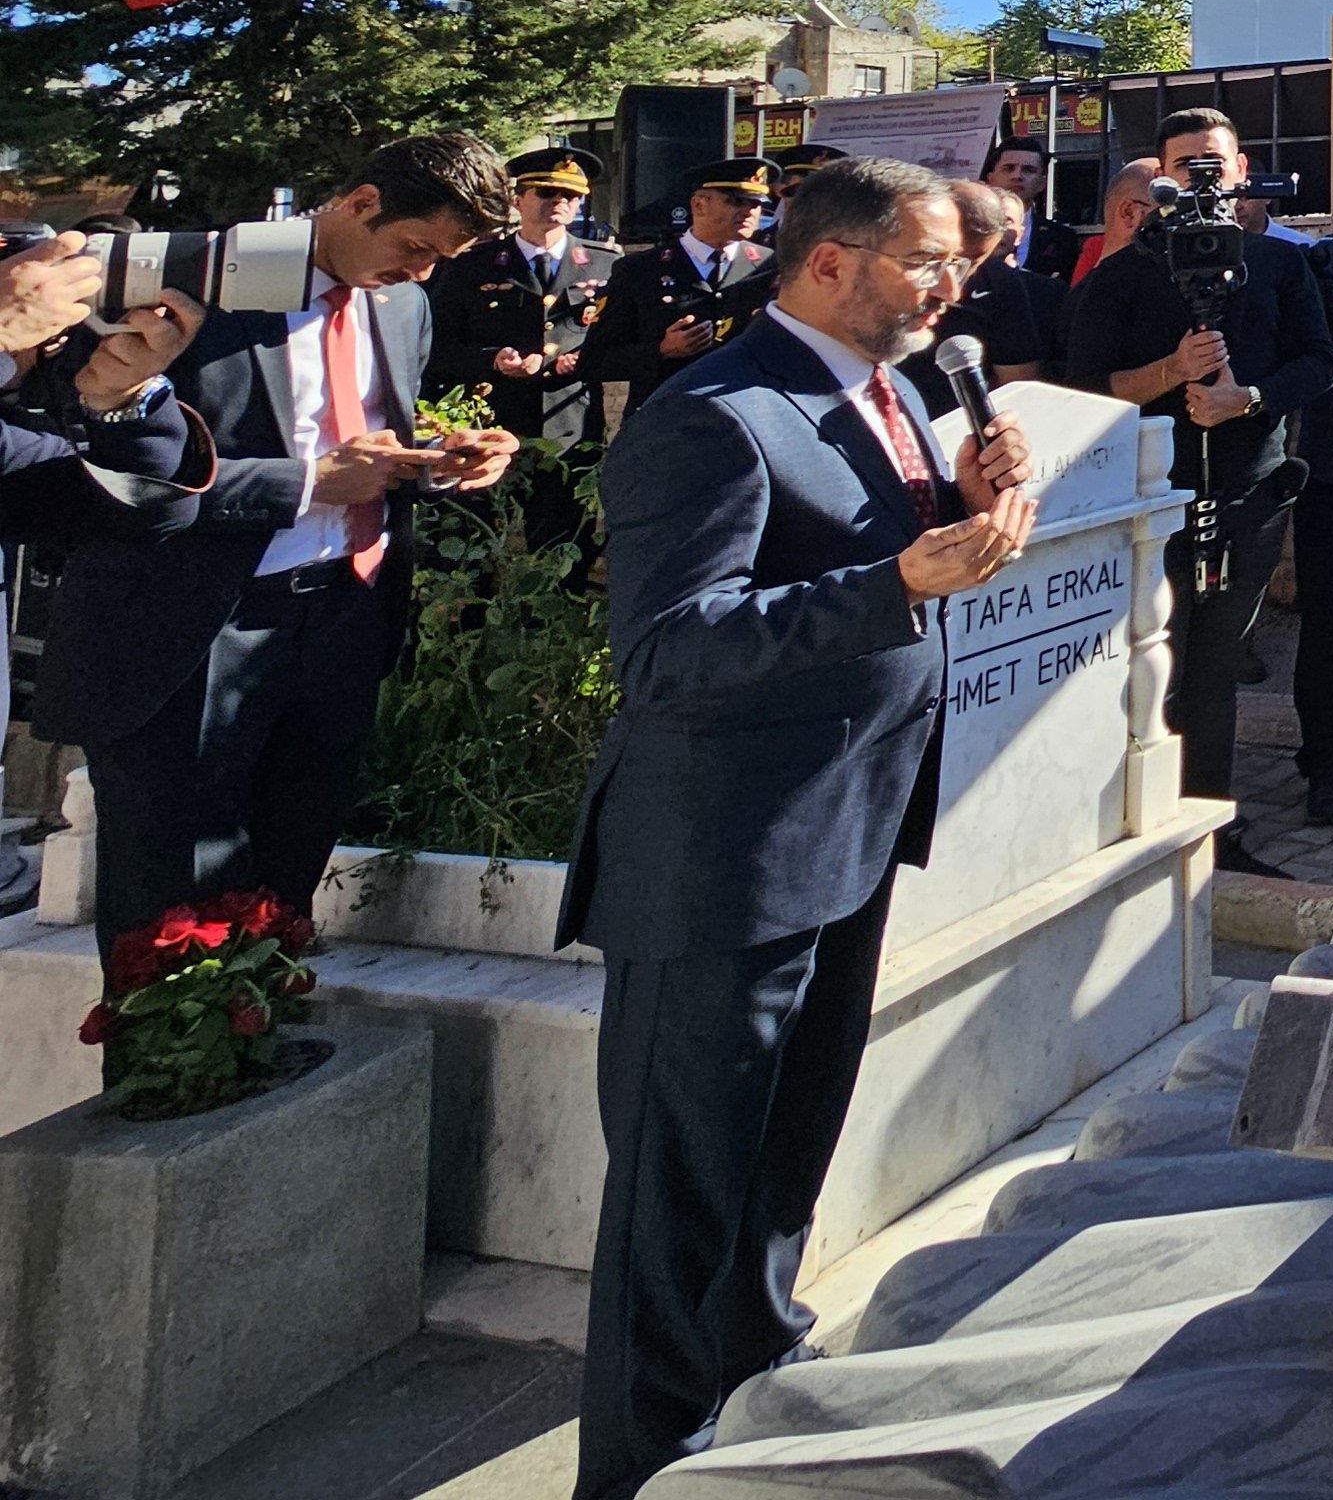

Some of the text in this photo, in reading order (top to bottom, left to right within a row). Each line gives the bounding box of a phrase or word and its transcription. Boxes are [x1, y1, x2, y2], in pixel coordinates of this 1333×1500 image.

[962, 558, 1125, 634] TAFA ERKAL
[1037, 628, 1120, 687] ERKAL
